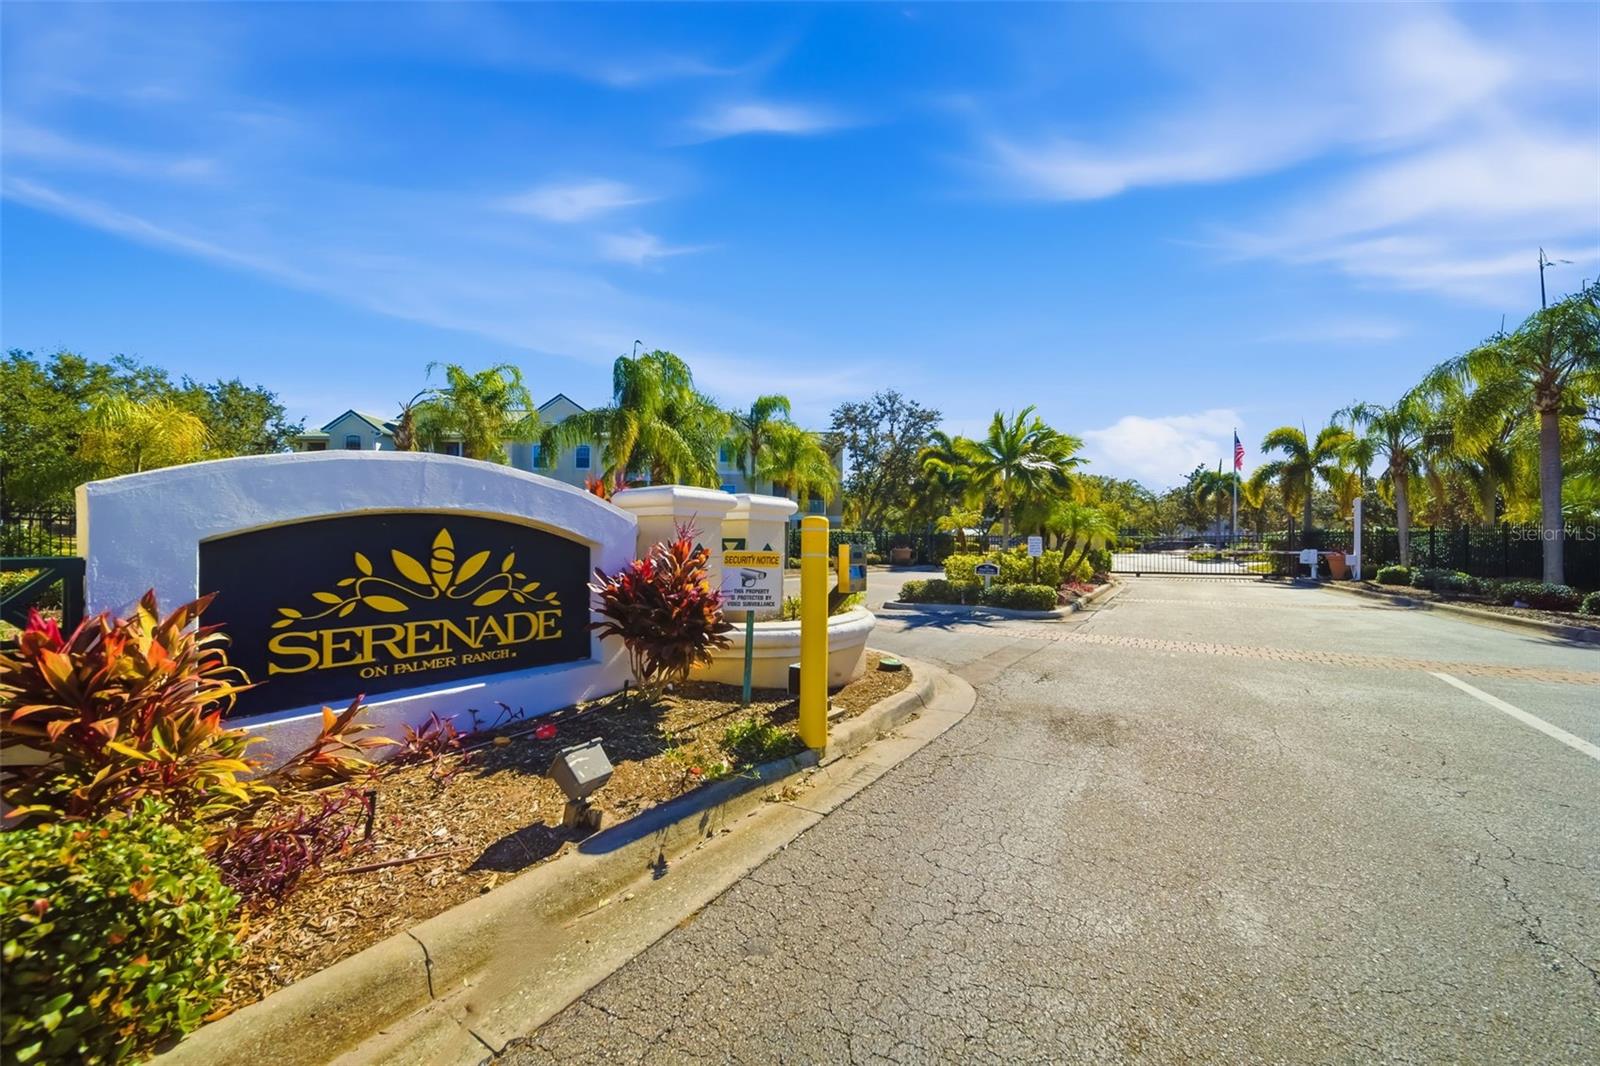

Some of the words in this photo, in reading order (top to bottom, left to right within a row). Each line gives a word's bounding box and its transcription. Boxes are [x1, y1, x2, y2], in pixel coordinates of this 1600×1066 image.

[724, 555, 755, 565] SECURITY
[756, 555, 780, 565] NOTICE
[268, 609, 563, 676] SERENADE
[360, 664, 389, 680] ON
[393, 656, 458, 675] PALMER
